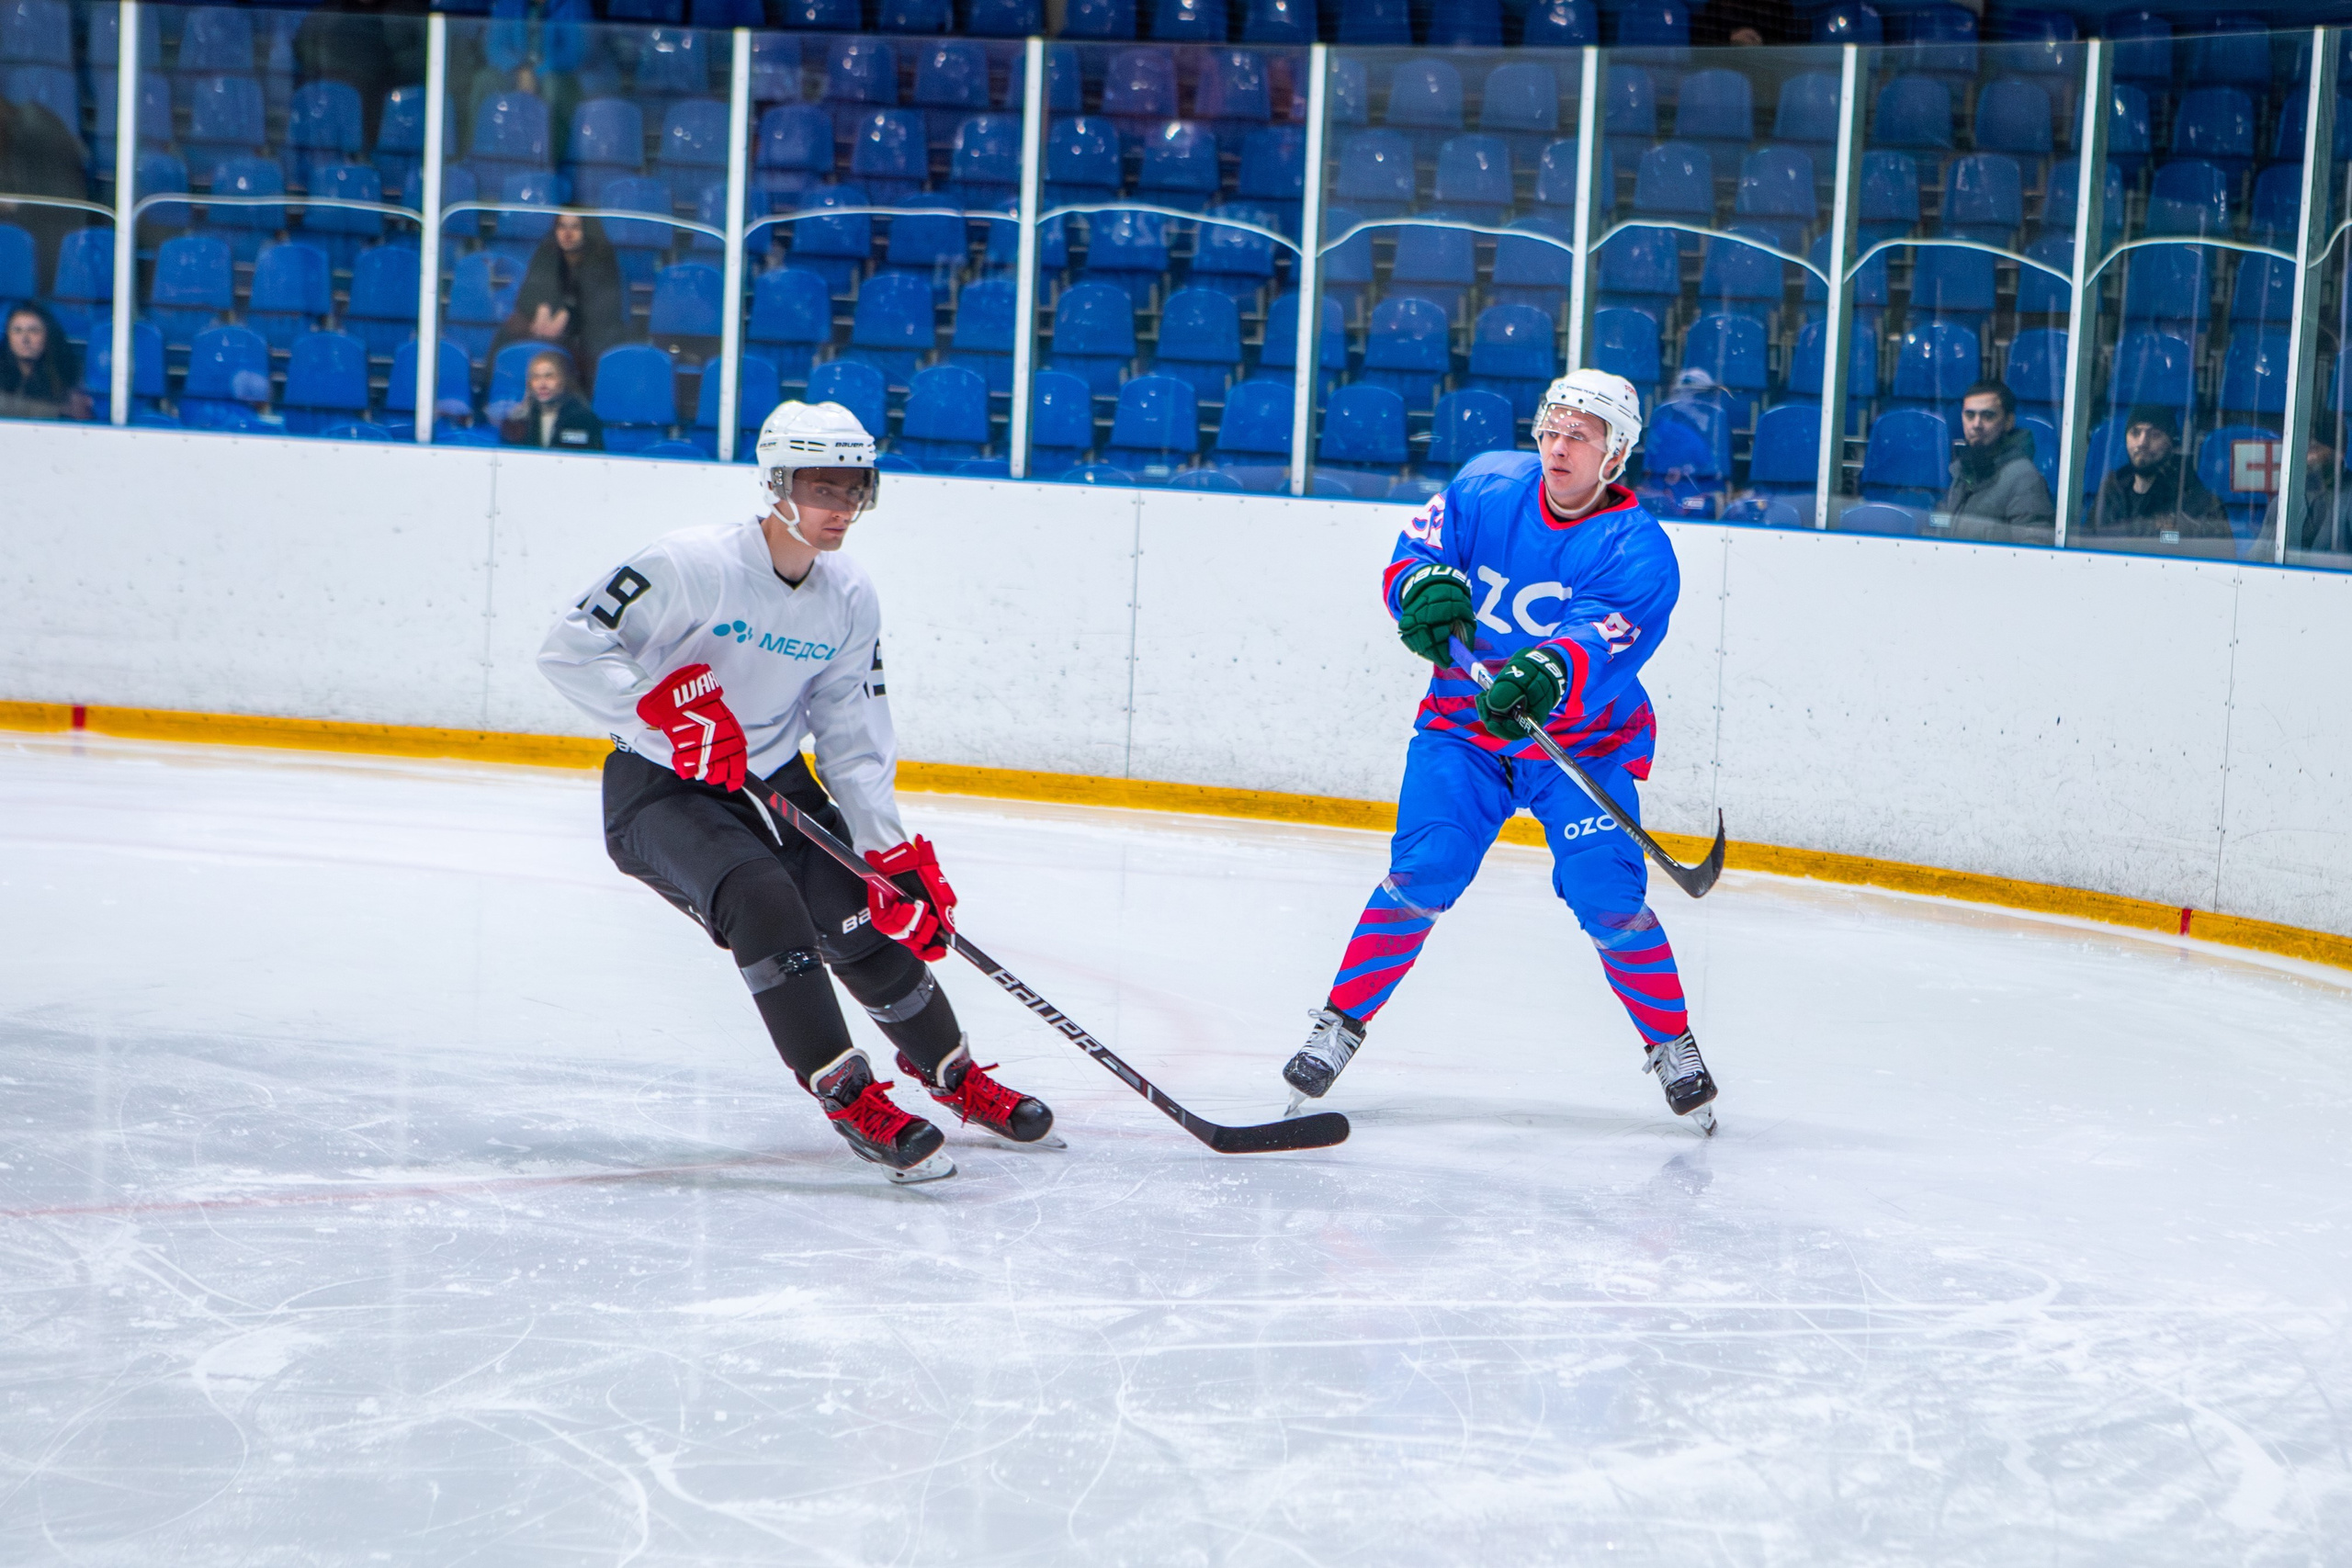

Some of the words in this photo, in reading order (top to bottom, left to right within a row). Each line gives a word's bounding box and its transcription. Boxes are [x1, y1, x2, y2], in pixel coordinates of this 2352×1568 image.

[576, 565, 652, 631] 9
[673, 671, 720, 708] WAR
[1564, 814, 1620, 840] OZO
[842, 907, 872, 934] BA
[989, 967, 1103, 1055] BAUER
